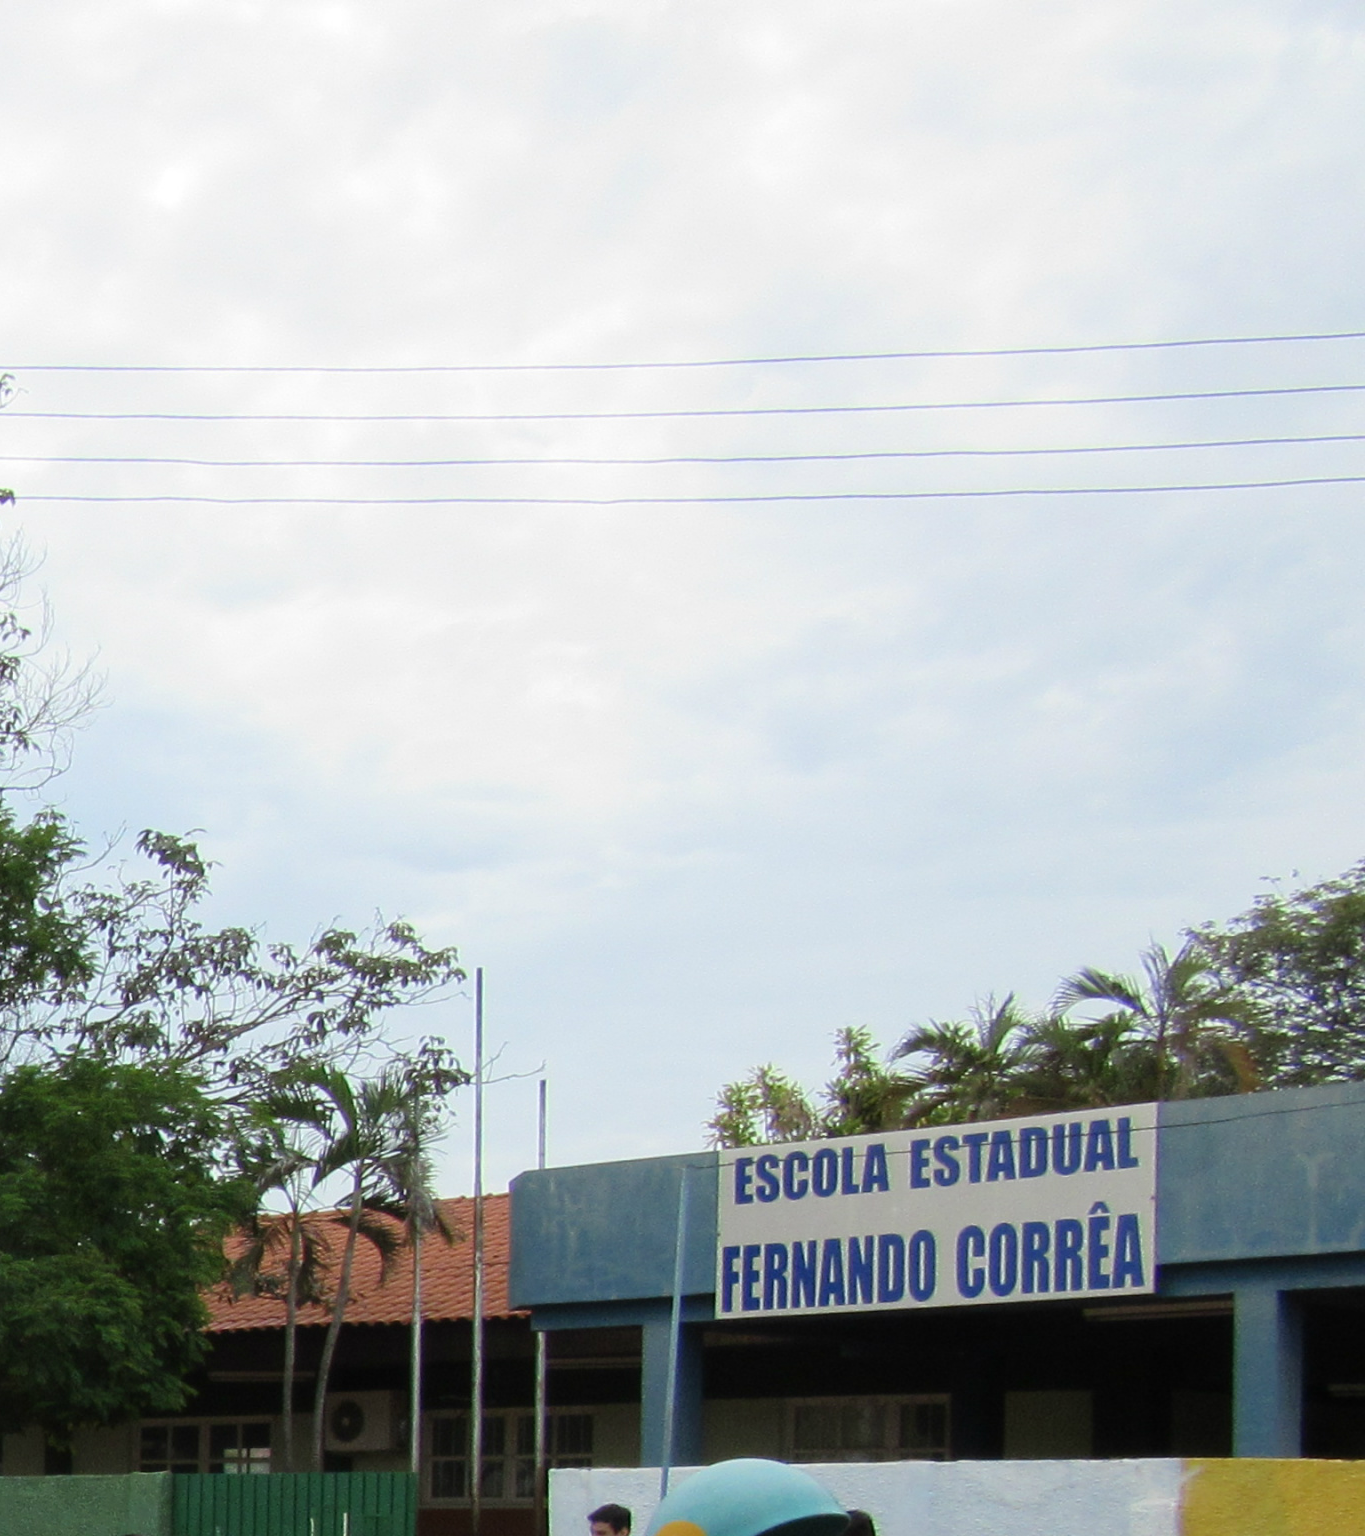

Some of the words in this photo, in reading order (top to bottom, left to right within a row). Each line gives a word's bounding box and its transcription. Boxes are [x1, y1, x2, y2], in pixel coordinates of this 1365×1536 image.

[734, 1142, 890, 1204] ESCOLA
[910, 1116, 1139, 1190] ESTADUAL
[721, 1229, 937, 1313] FERNANDO
[956, 1201, 1145, 1299] CORRÊA
